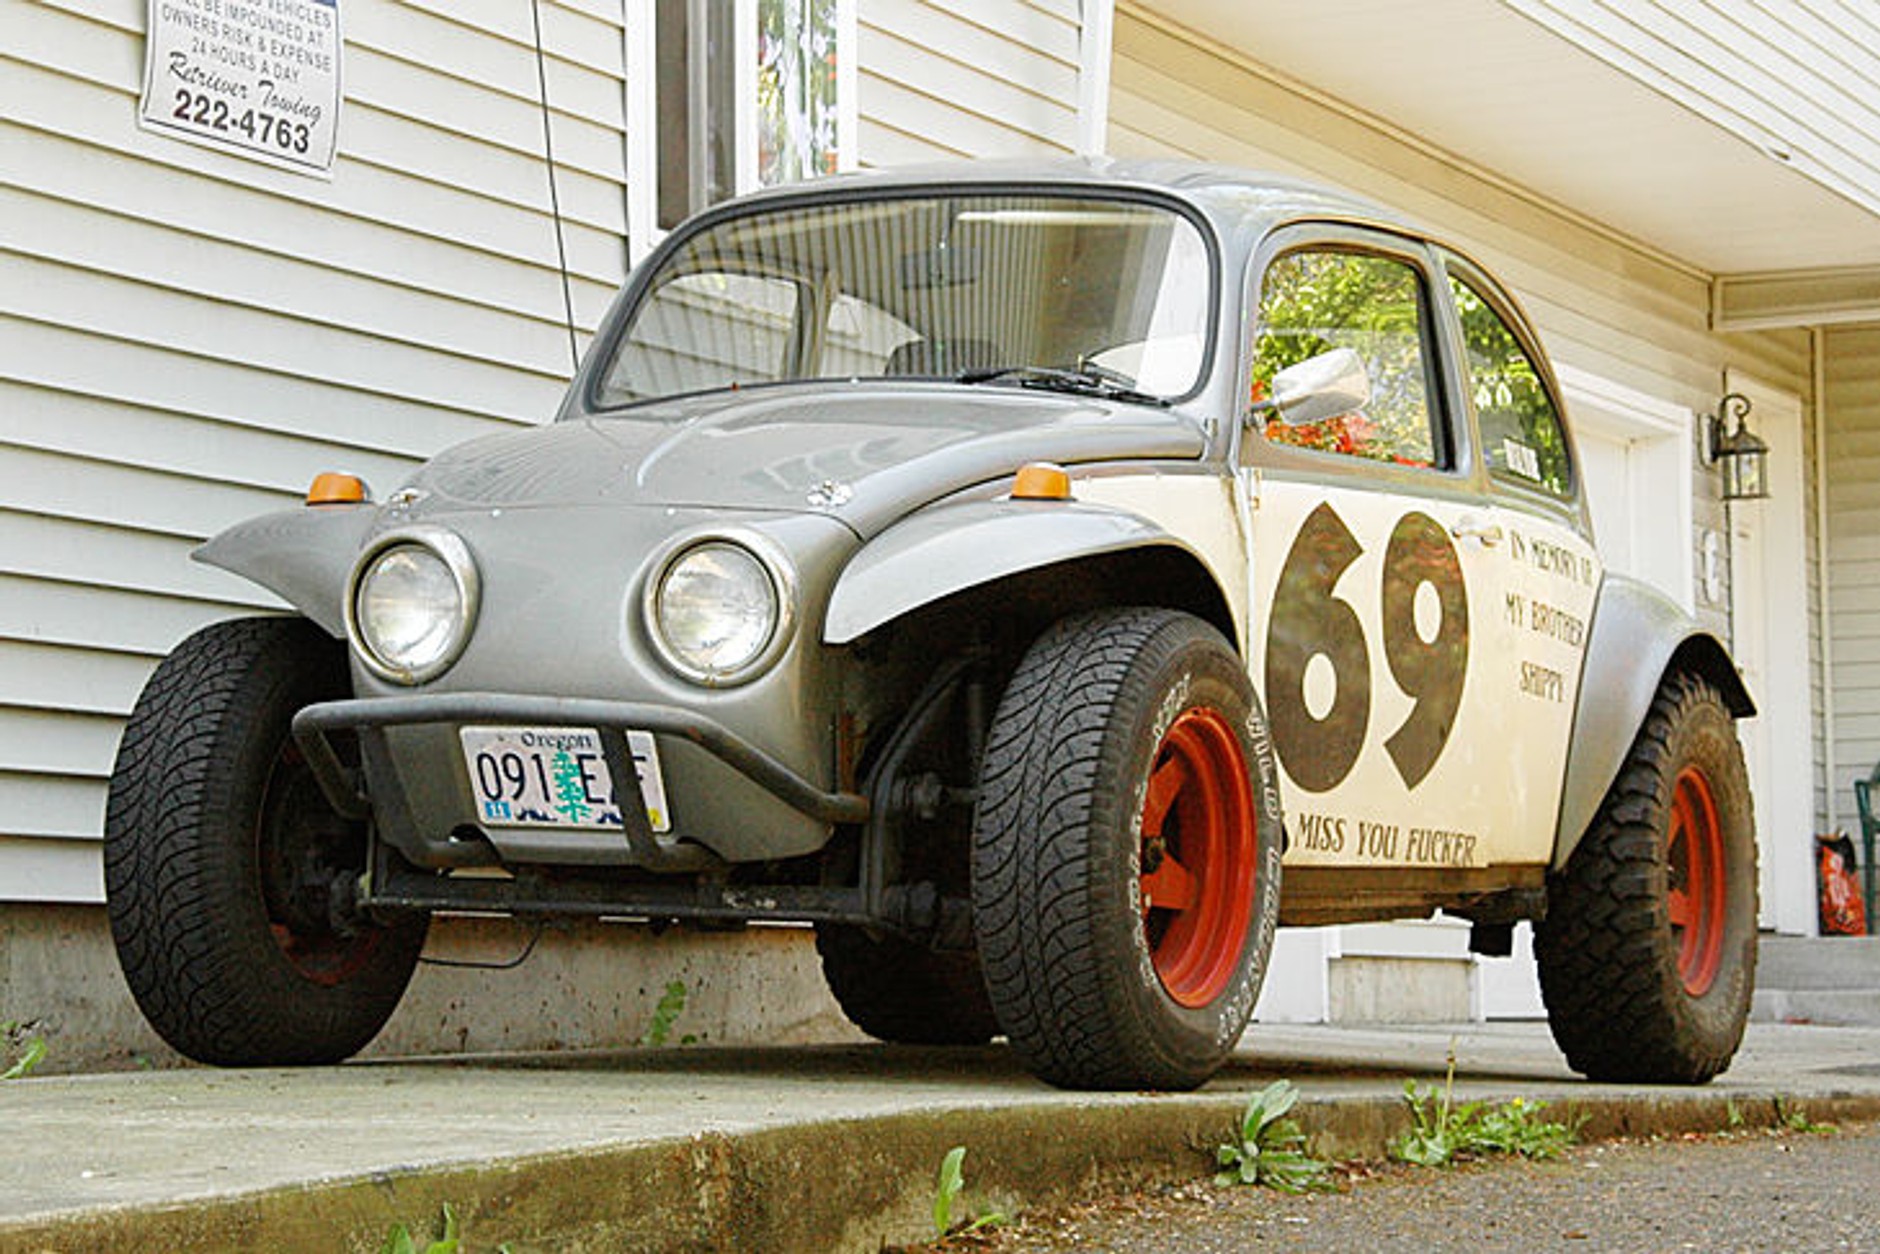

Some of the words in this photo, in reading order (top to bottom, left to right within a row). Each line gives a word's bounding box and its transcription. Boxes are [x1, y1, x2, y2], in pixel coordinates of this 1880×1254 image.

[162, 4, 219, 37] OWNERS
[222, 23, 254, 47] RISK
[270, 38, 331, 73] EXPENSE
[224, 3, 303, 42] IMPOUNDED
[210, 40, 256, 72] HOURS
[260, 59, 270, 75] A
[274, 62, 300, 83] DAY
[168, 50, 248, 99] Retriever
[258, 80, 321, 128] Towing
[173, 89, 309, 153] 222-4763
[1264, 500, 1469, 793] 69
[1531, 600, 1585, 647] BROTHER
[521, 731, 592, 750] Oregon
[477, 753, 550, 803] 091
[1294, 812, 1347, 852] MISS
[1357, 820, 1399, 860] YOU
[1405, 828, 1477, 868] FUCKER
